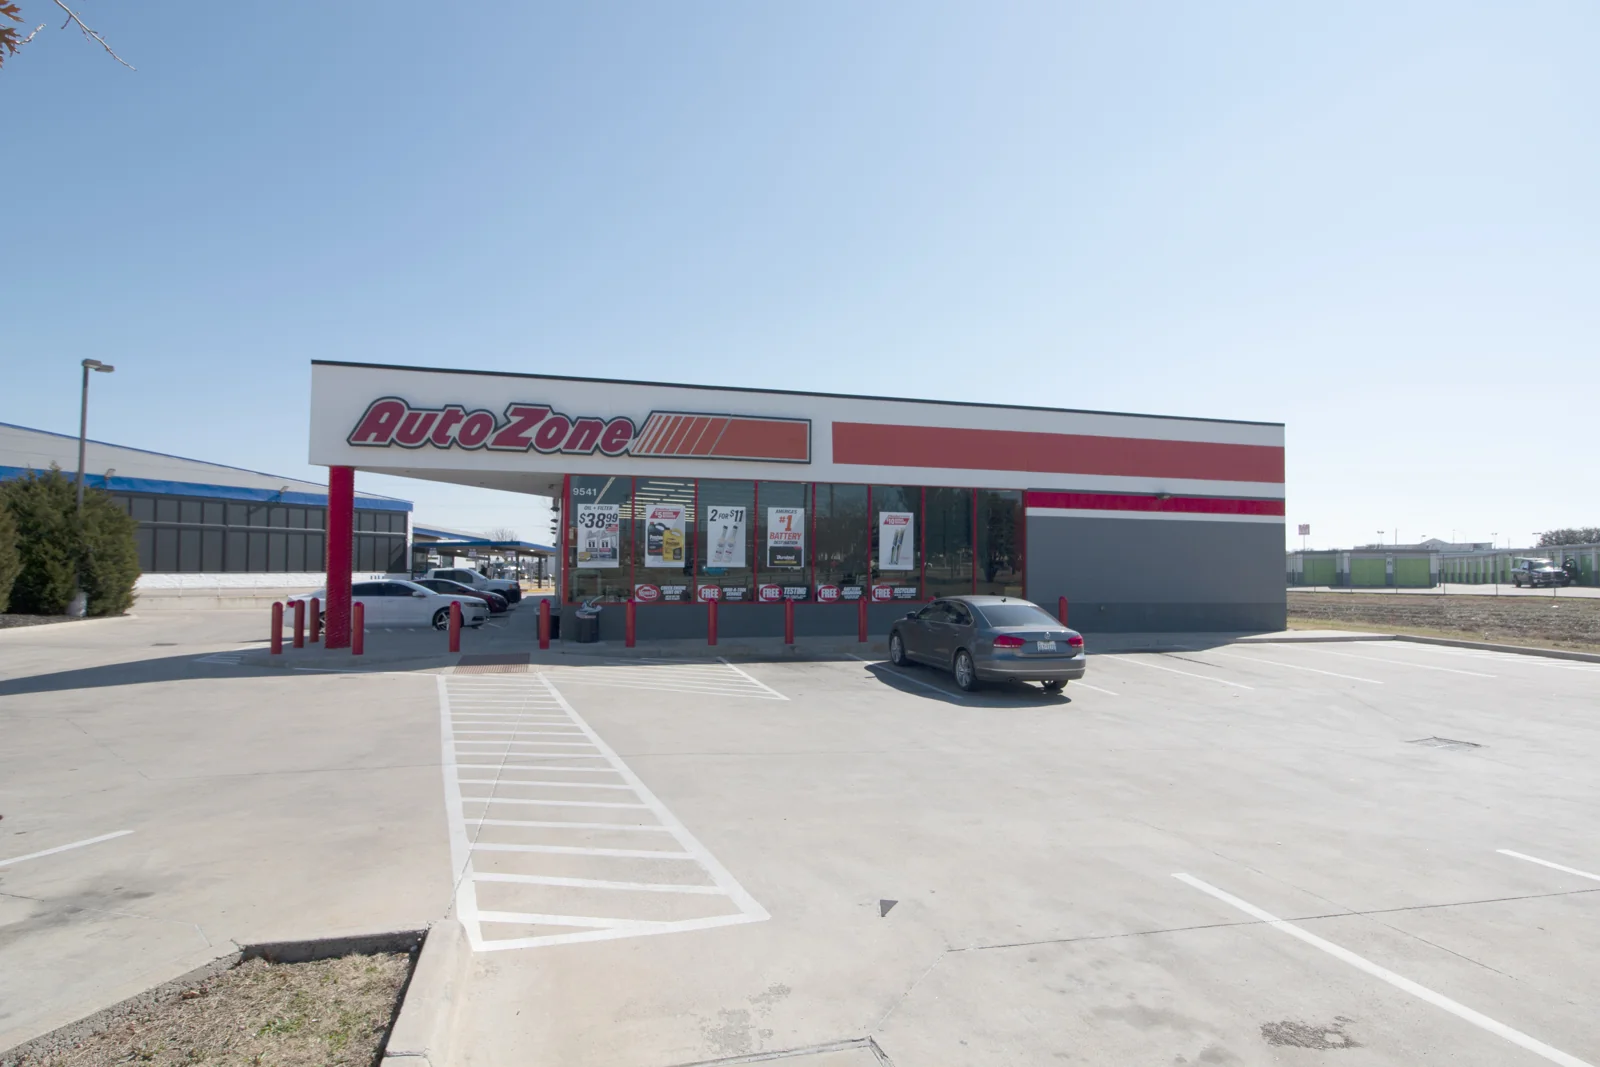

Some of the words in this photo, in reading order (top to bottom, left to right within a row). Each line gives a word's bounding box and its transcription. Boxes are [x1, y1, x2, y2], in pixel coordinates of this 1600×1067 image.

[348, 397, 636, 456] AutoZone
[573, 488, 597, 496] 9541
[709, 509, 719, 522] 2
[730, 510, 744, 522] $11
[779, 515, 793, 531] #1
[770, 532, 802, 540] BATTERY
[702, 588, 719, 598] FREE
[763, 588, 780, 598] FREE
[821, 588, 837, 598] FREE
[875, 588, 891, 598] FREE
